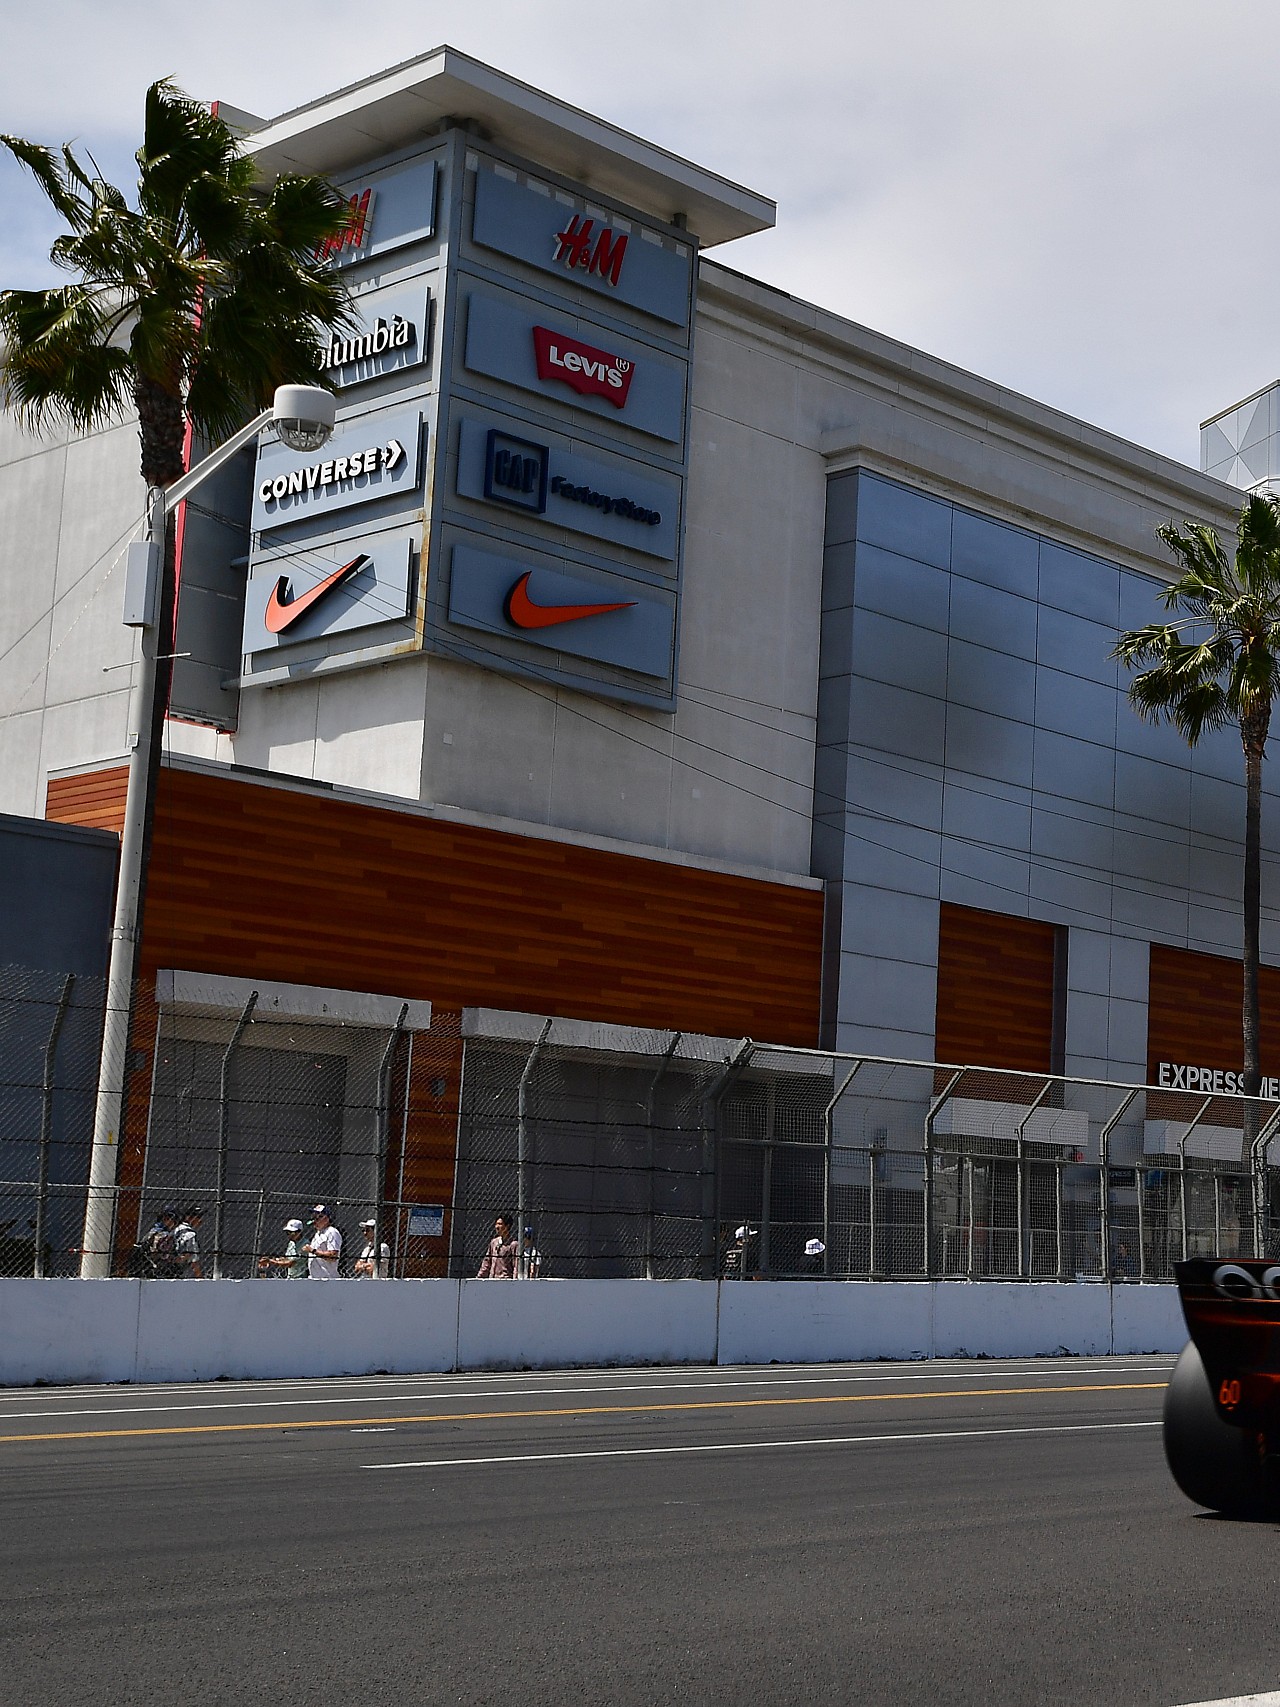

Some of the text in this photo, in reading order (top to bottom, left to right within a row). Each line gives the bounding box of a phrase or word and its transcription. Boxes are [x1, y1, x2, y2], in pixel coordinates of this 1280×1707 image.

[553, 214, 629, 287] H&M
[312, 314, 410, 372] olumbia
[258, 447, 378, 503] CONVERSE
[495, 449, 539, 493] GAP
